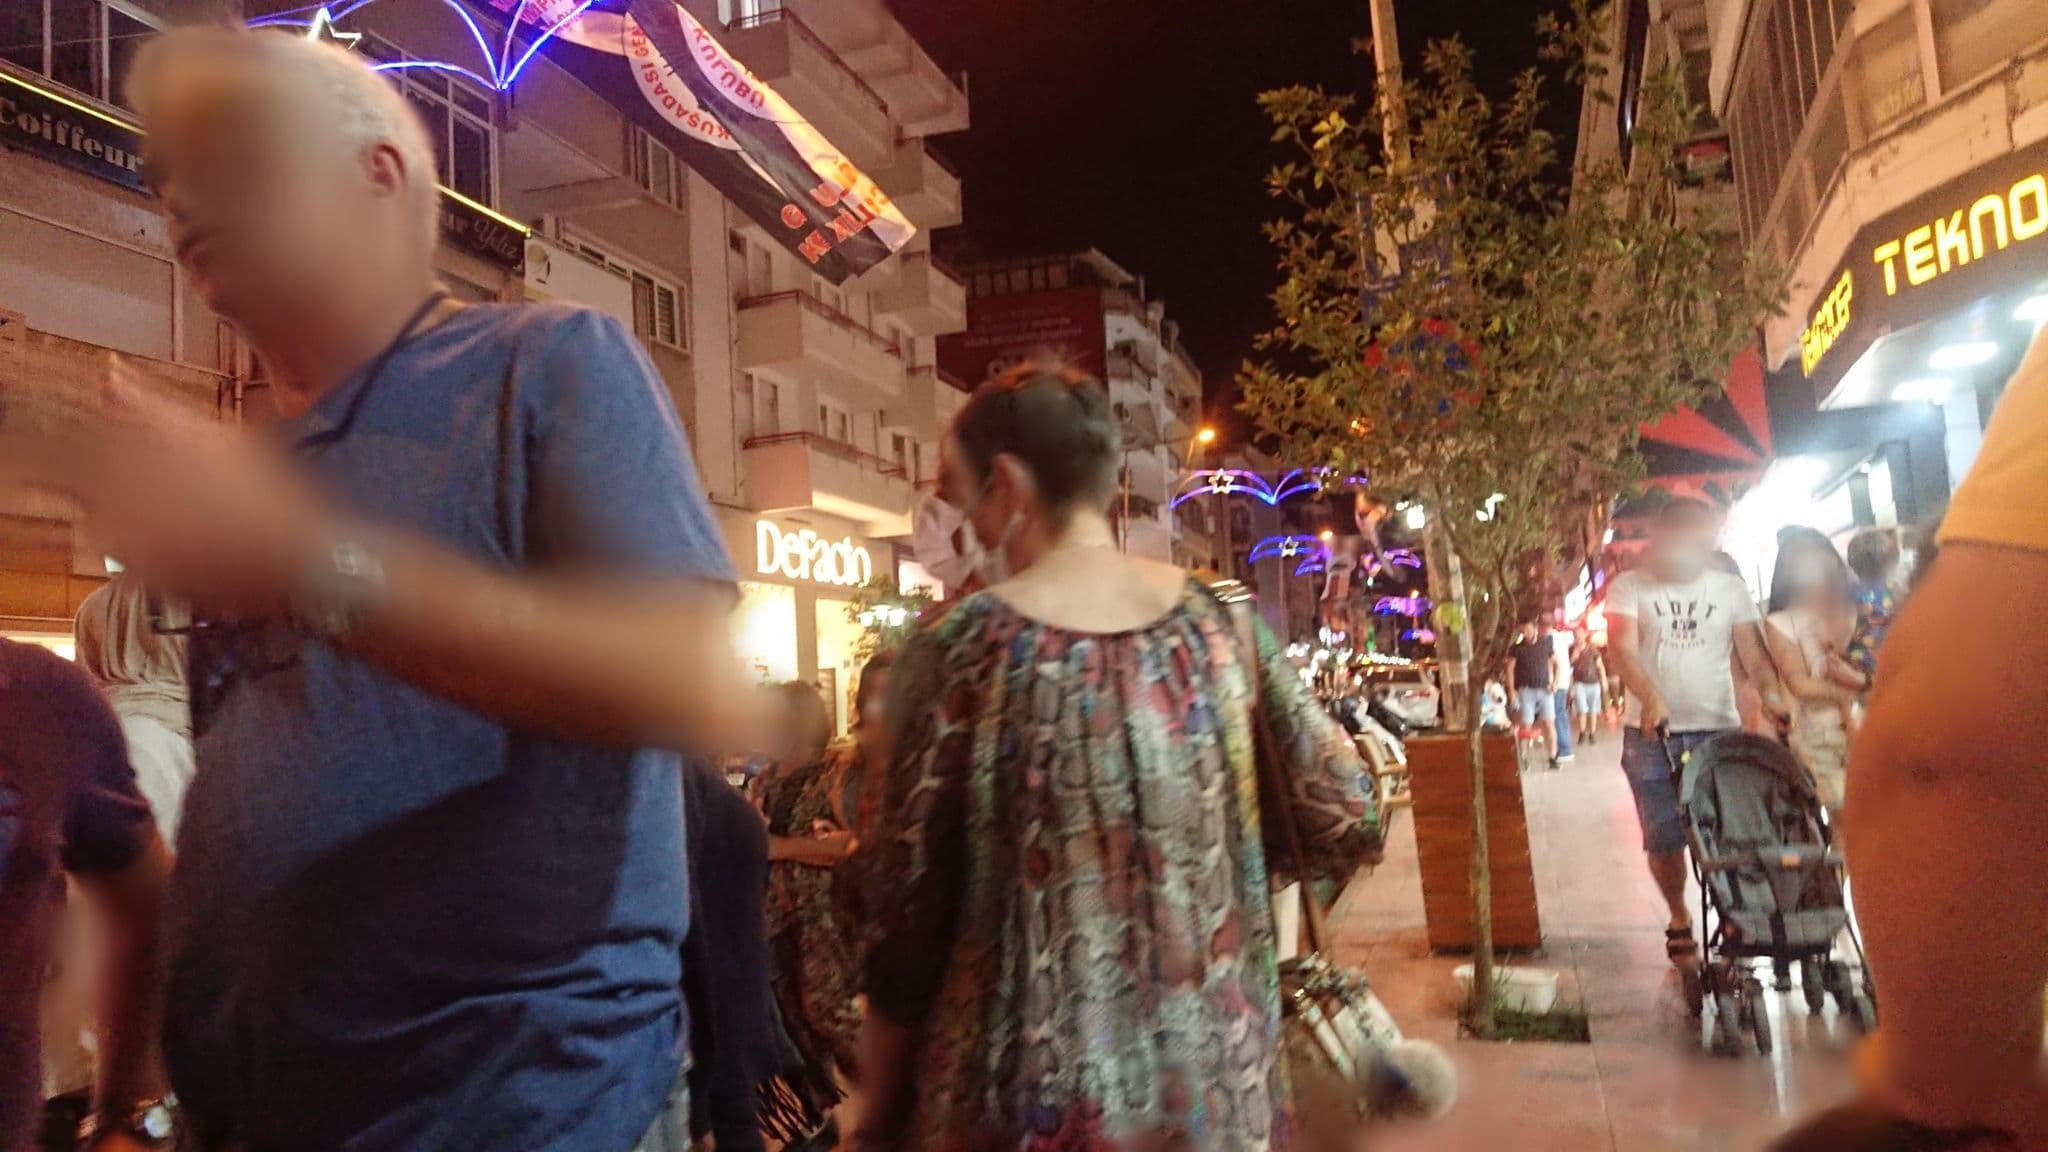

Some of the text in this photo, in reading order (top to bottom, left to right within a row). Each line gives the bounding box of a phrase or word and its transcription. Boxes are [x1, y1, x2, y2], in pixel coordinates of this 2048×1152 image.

[0, 97, 145, 173] Coiffeur
[756, 519, 872, 587] DeFacto
[1653, 600, 1717, 620] LOFT
